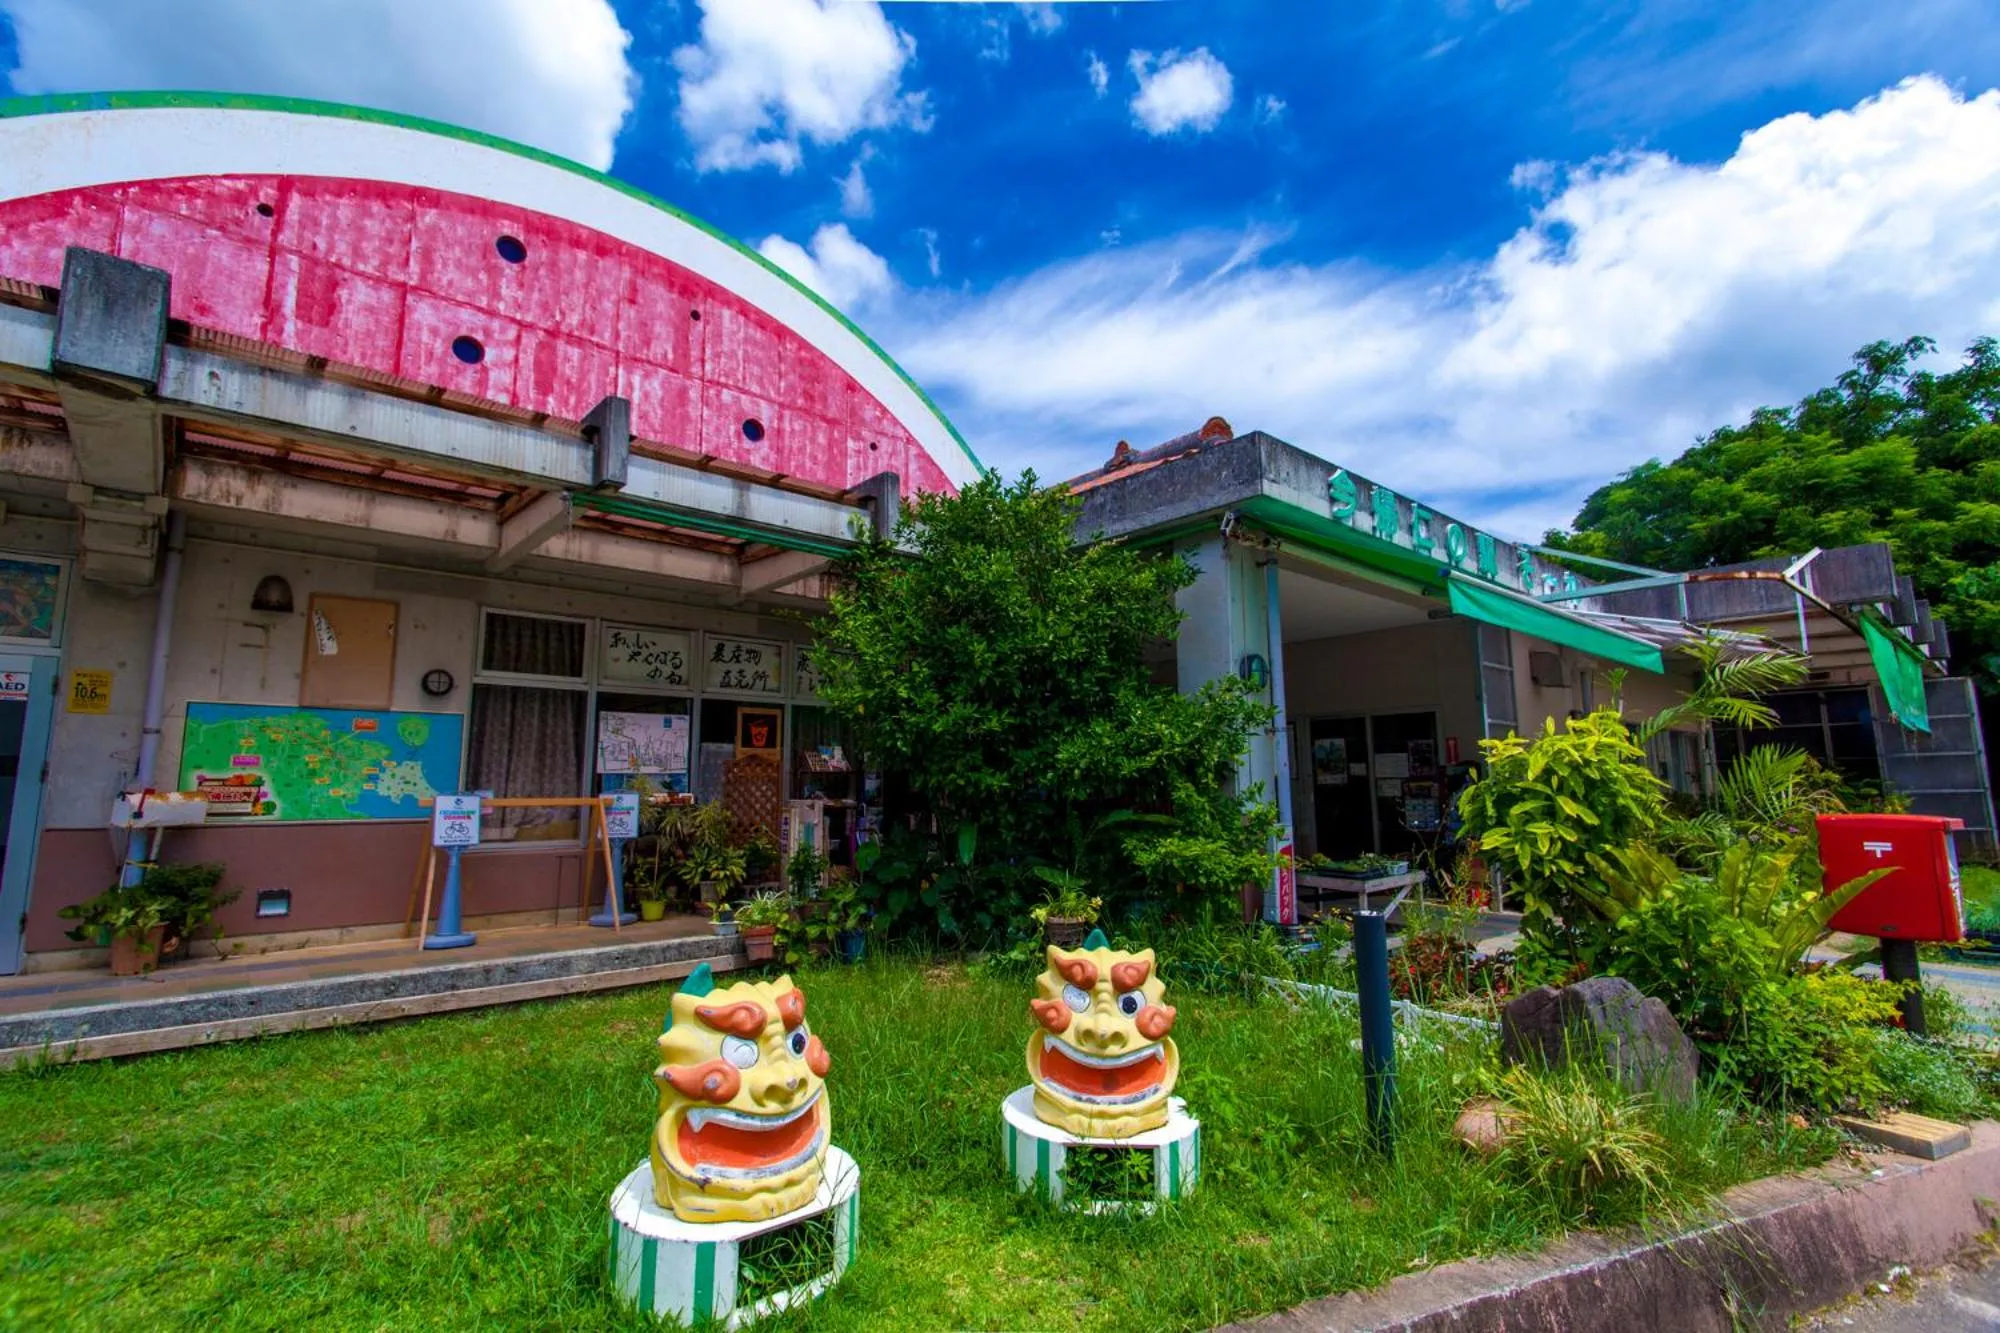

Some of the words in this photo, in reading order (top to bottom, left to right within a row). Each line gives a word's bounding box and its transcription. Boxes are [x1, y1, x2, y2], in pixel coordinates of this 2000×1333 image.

[609, 631, 657, 649] おいしい
[710, 642, 762, 666] 農産物
[719, 668, 770, 692] 直売所
